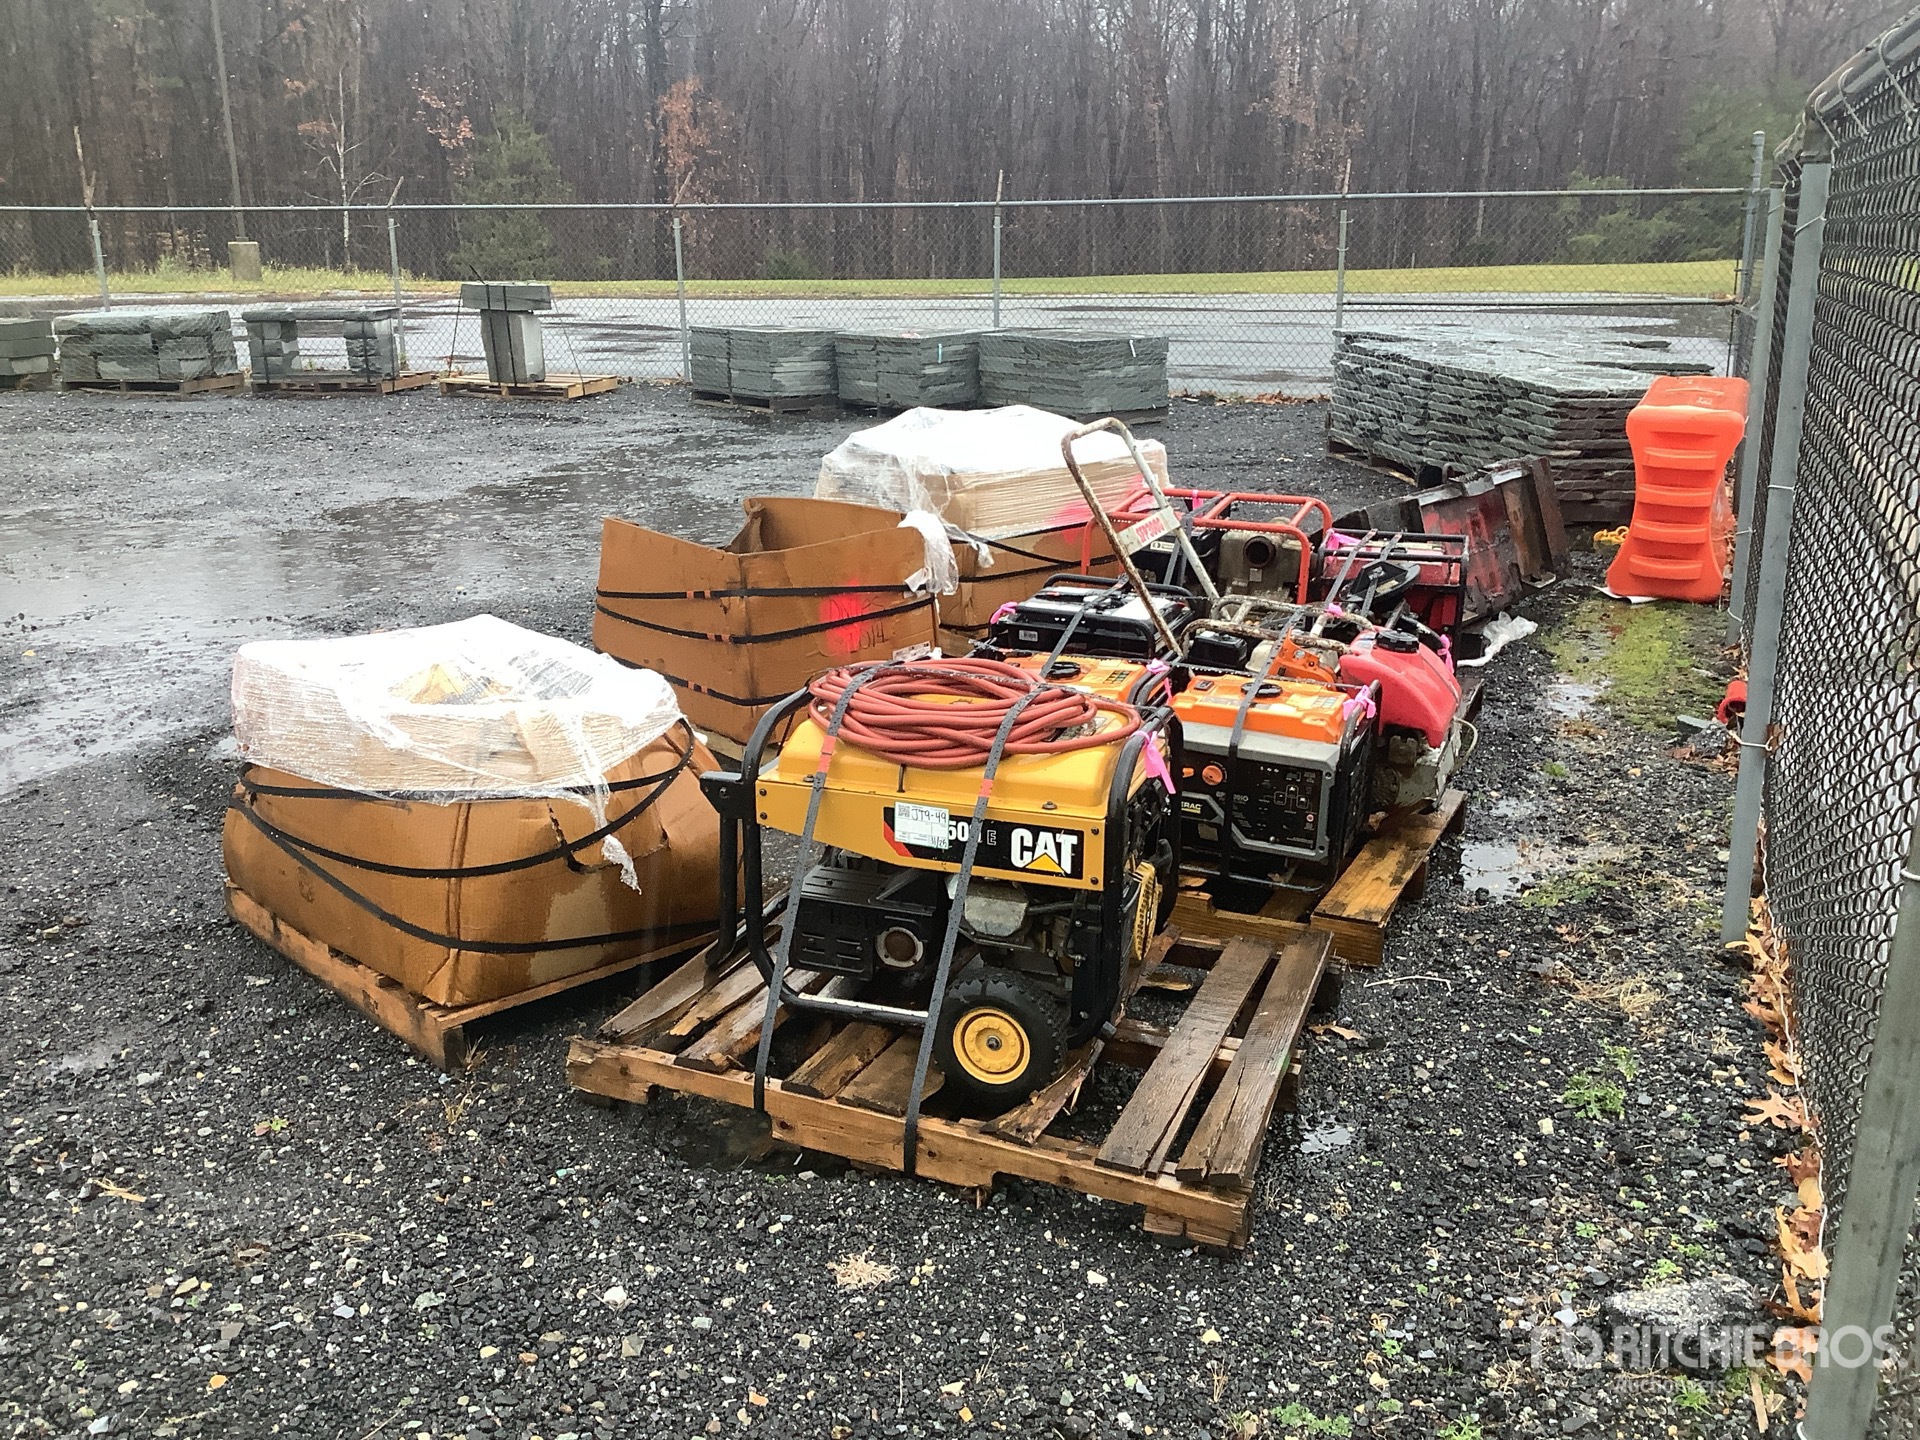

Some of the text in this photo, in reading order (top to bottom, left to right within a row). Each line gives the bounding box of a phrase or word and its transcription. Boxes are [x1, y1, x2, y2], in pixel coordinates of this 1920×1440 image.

[911, 808, 947, 824] JT9-49
[948, 820, 982, 844] 50
[986, 829, 997, 846] E
[1010, 827, 1078, 875] CAT
